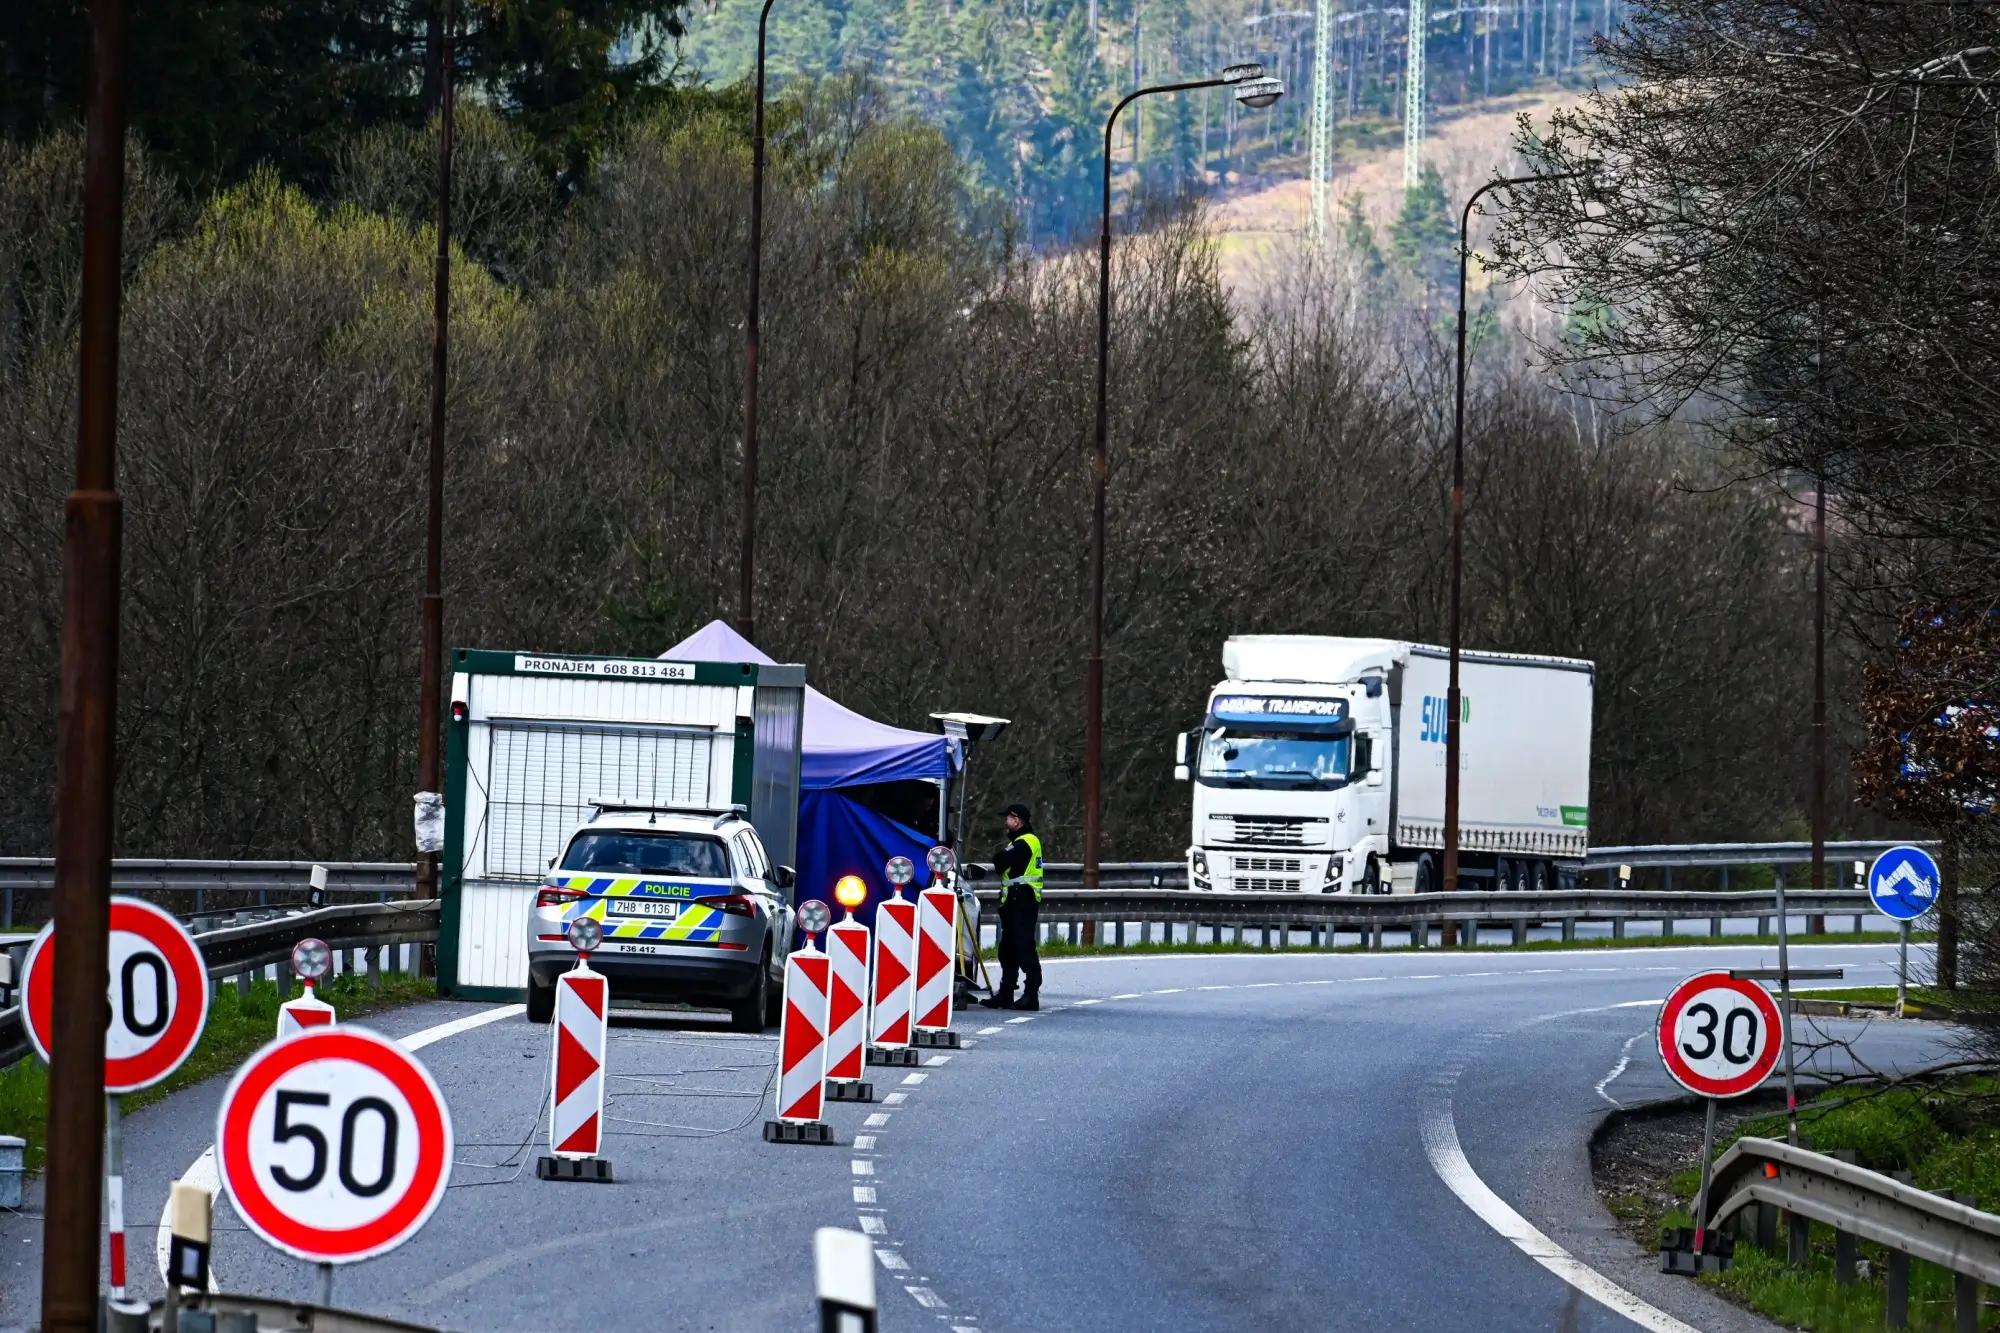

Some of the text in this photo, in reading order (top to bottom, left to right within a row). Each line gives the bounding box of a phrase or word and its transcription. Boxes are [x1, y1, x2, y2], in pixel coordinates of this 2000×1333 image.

[603, 663, 628, 675] 608
[631, 665, 656, 677] 813
[660, 667, 686, 678] 484
[1268, 699, 1342, 715] TRANSPORT
[645, 884, 691, 897] POLICIE
[616, 901, 670, 914] 7H8 8136
[620, 945, 656, 954] F36 412
[105, 951, 169, 1037] 0
[1683, 1003, 1757, 1064] 30
[270, 1090, 399, 1198] 50
